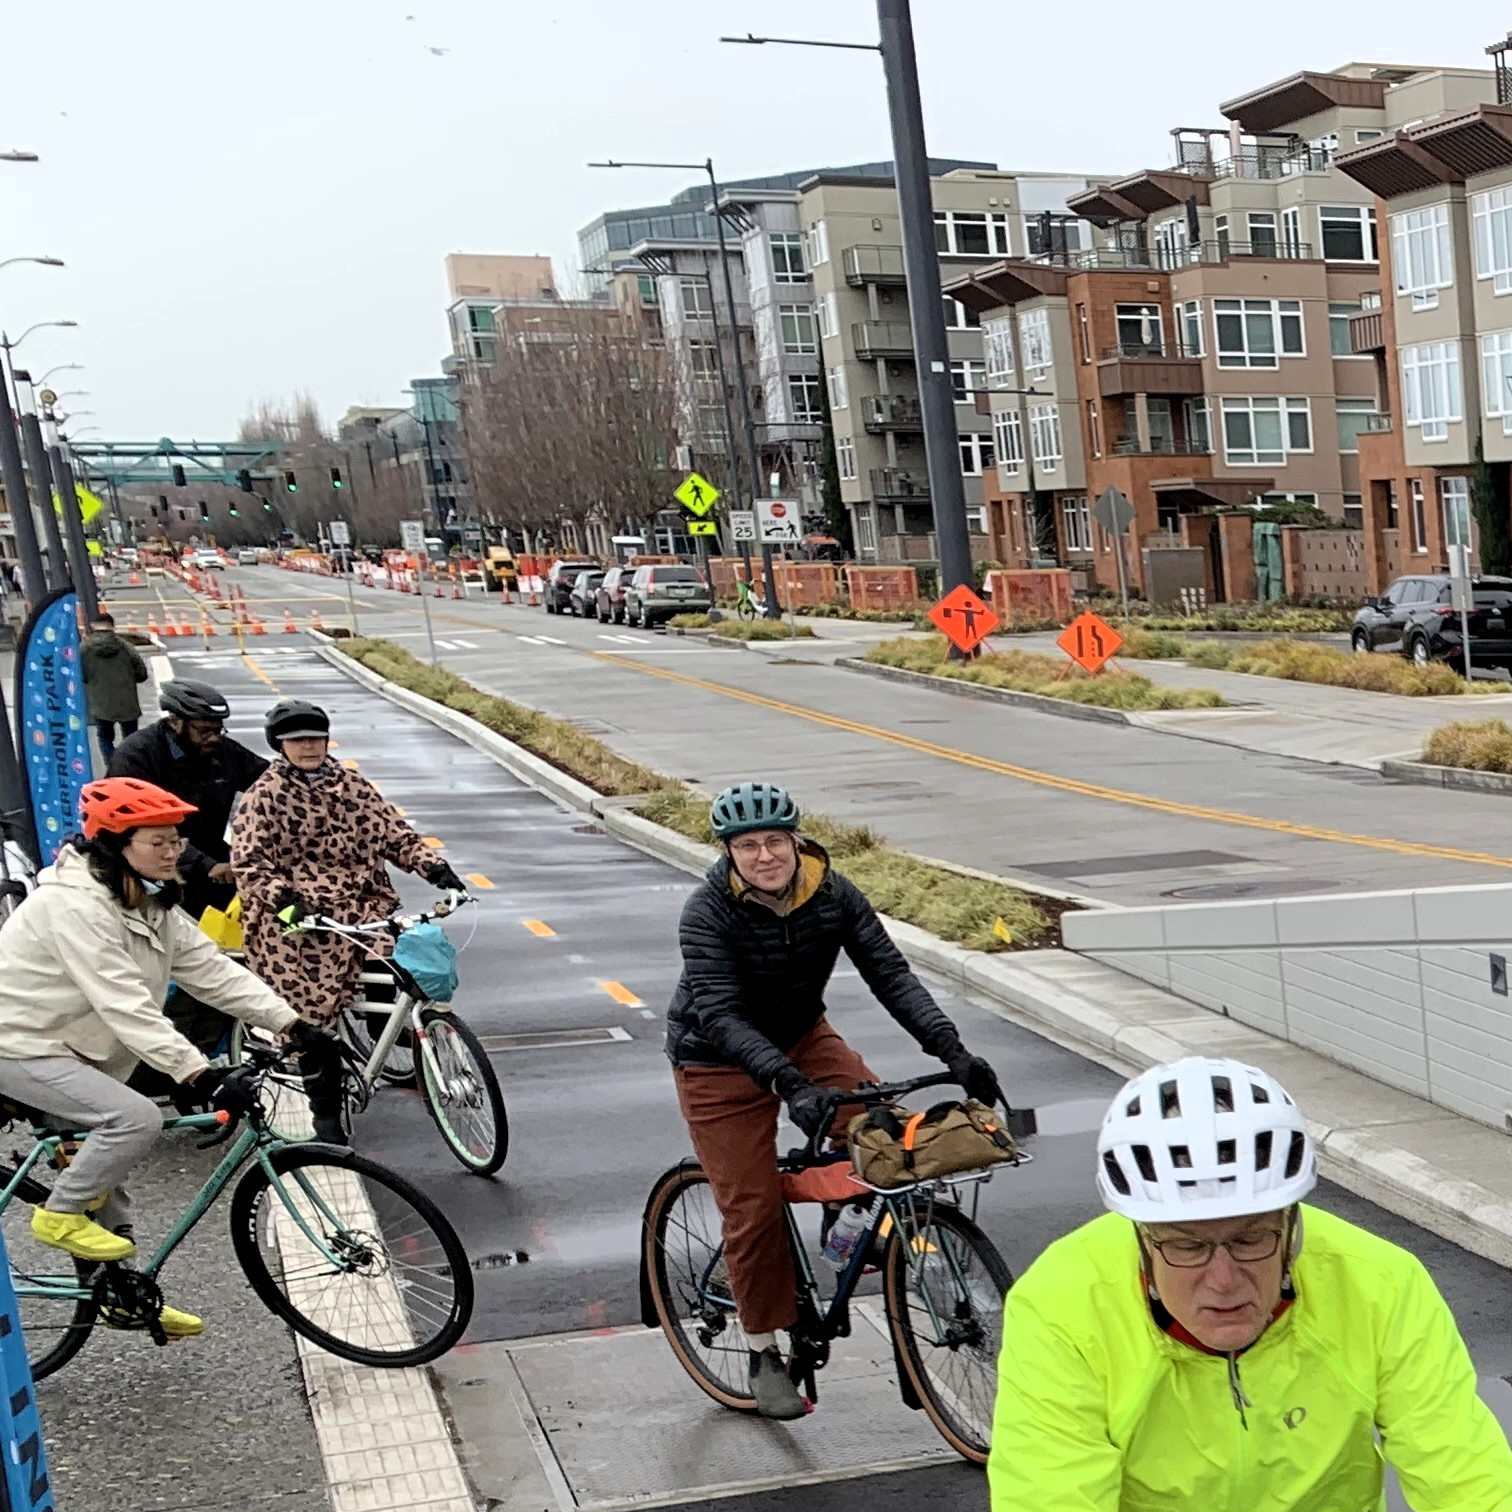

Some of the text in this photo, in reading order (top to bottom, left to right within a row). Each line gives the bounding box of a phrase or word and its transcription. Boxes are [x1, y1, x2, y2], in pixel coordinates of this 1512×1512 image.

[735, 526, 753, 538] 25
[40, 654, 74, 834] TERFRONT PARK
